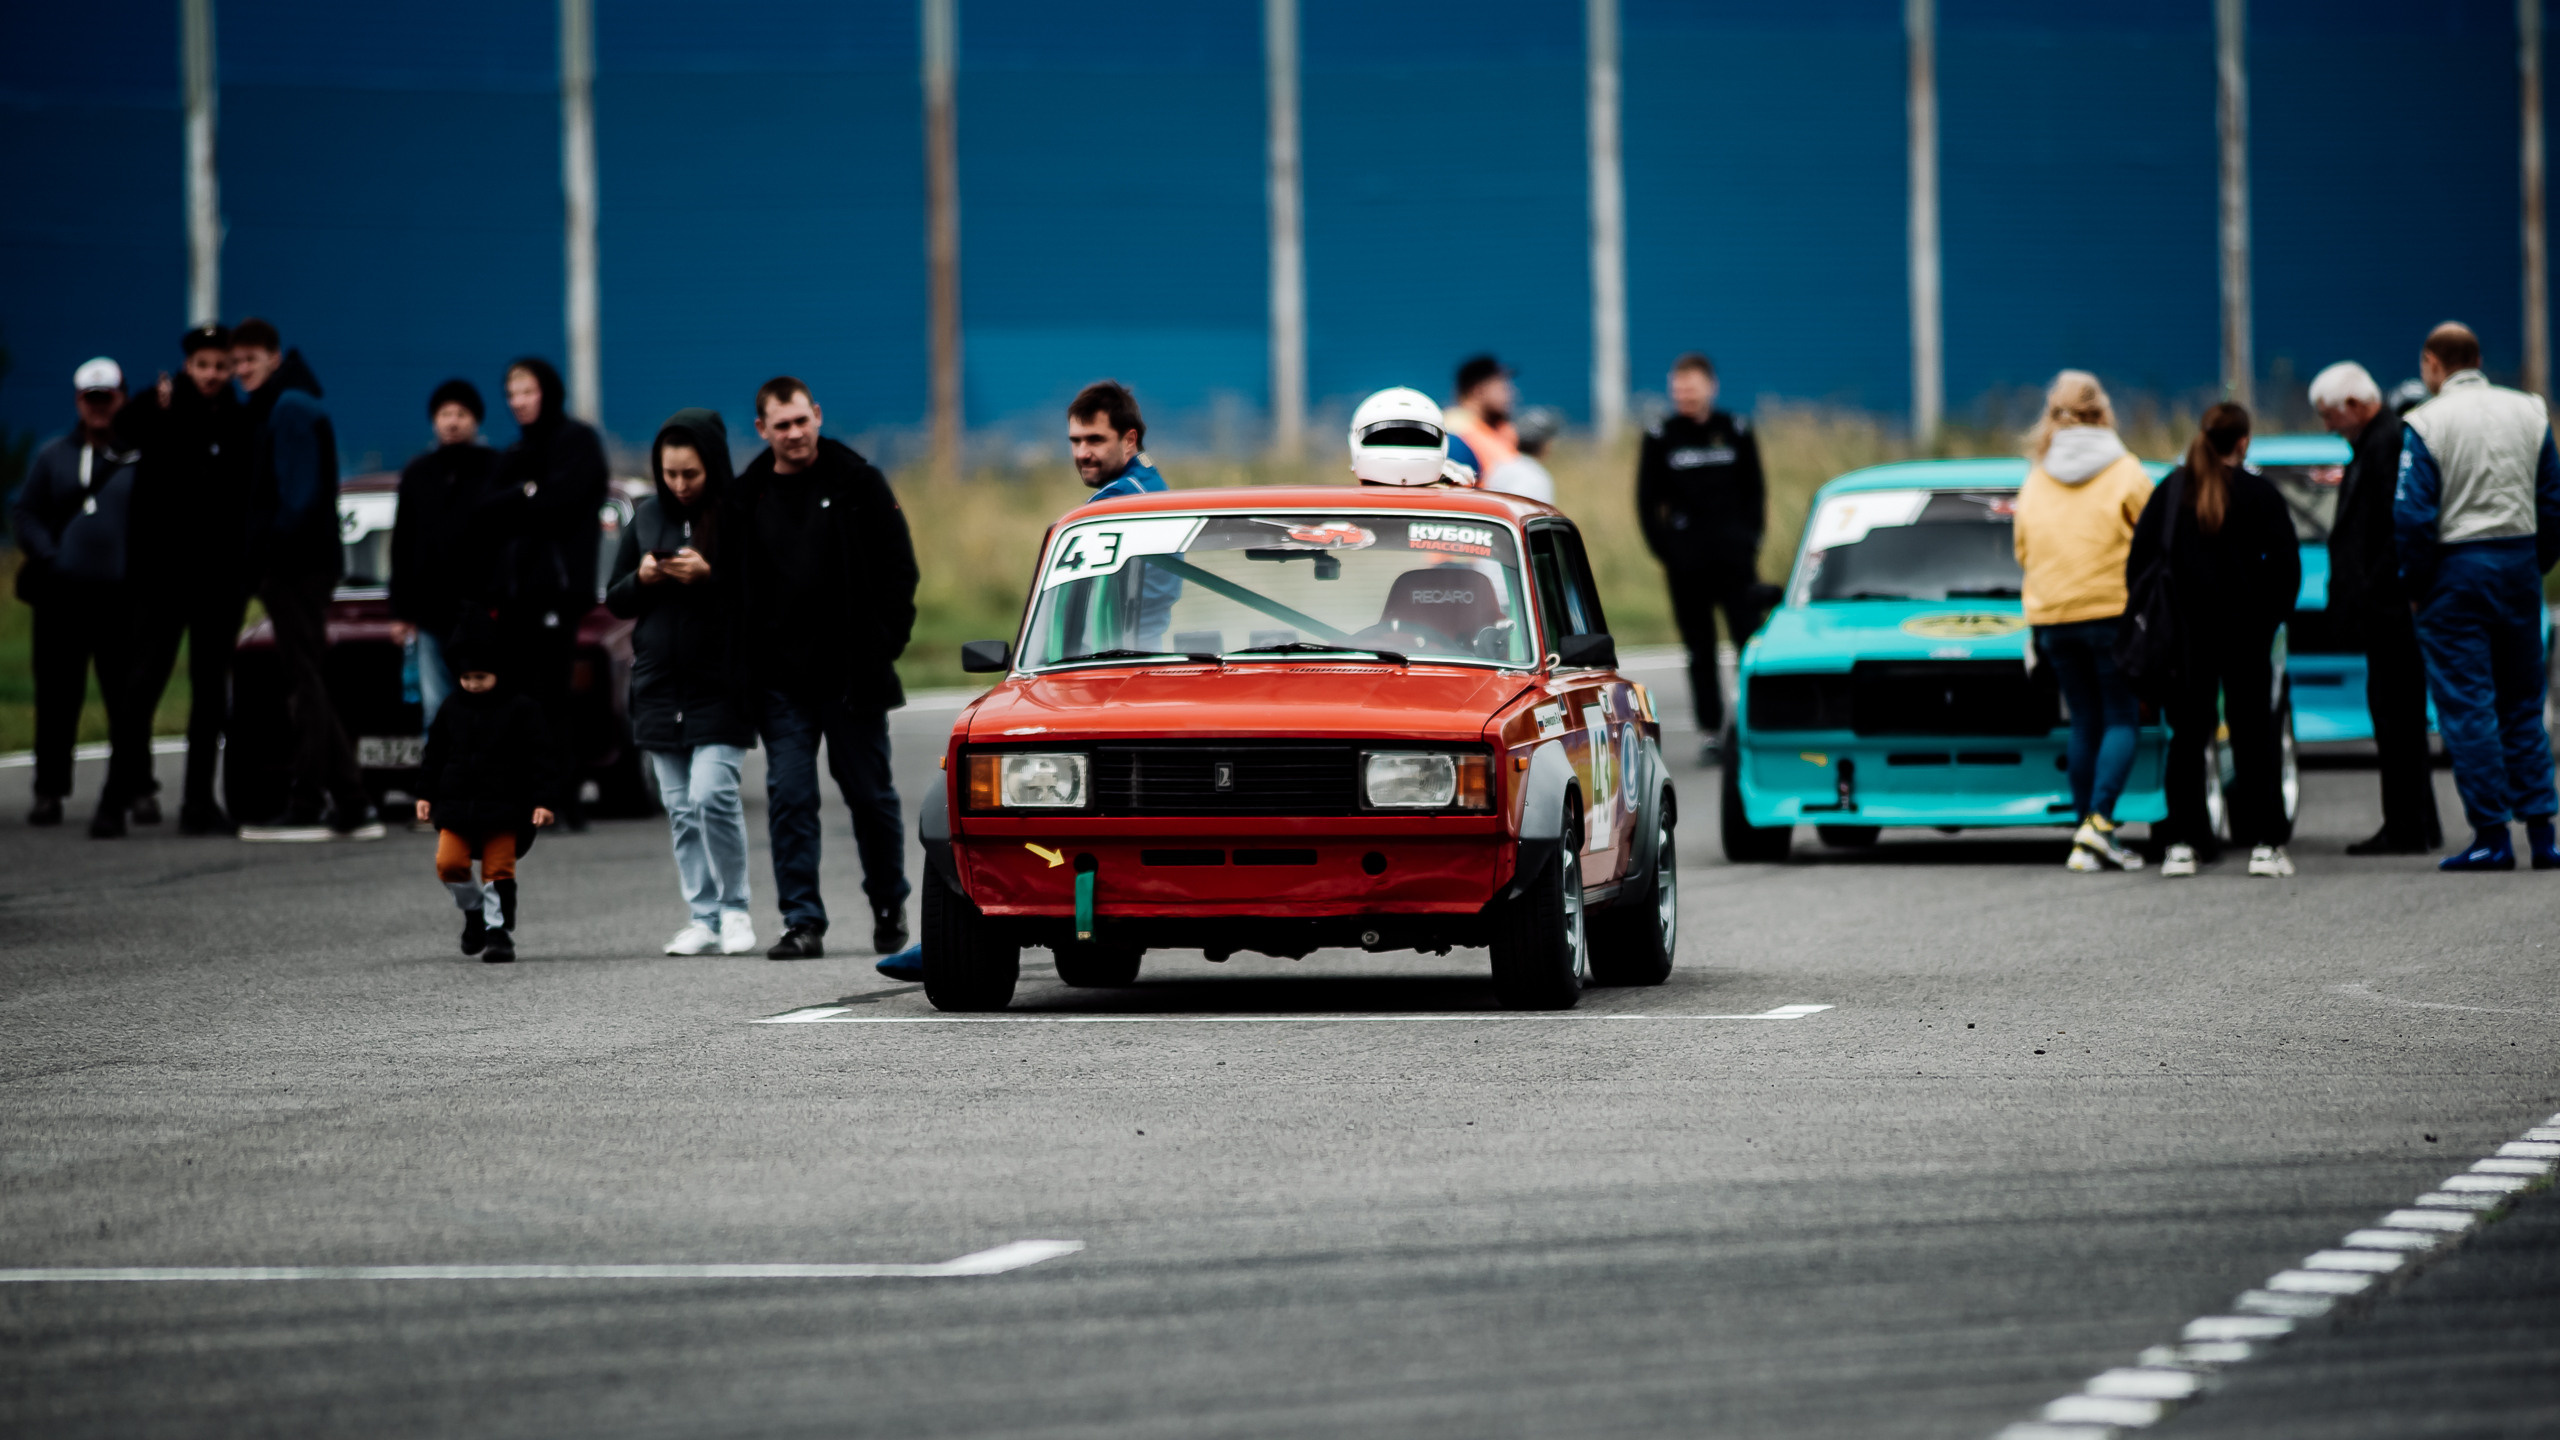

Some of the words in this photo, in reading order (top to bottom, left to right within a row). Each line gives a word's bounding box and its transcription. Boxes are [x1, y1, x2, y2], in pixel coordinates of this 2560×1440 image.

[1409, 523, 1493, 547] КУБОК
[1055, 532, 1123, 572] 43
[1409, 540, 1492, 557] КЛАССИКИ
[1412, 590, 1474, 604] RECARO
